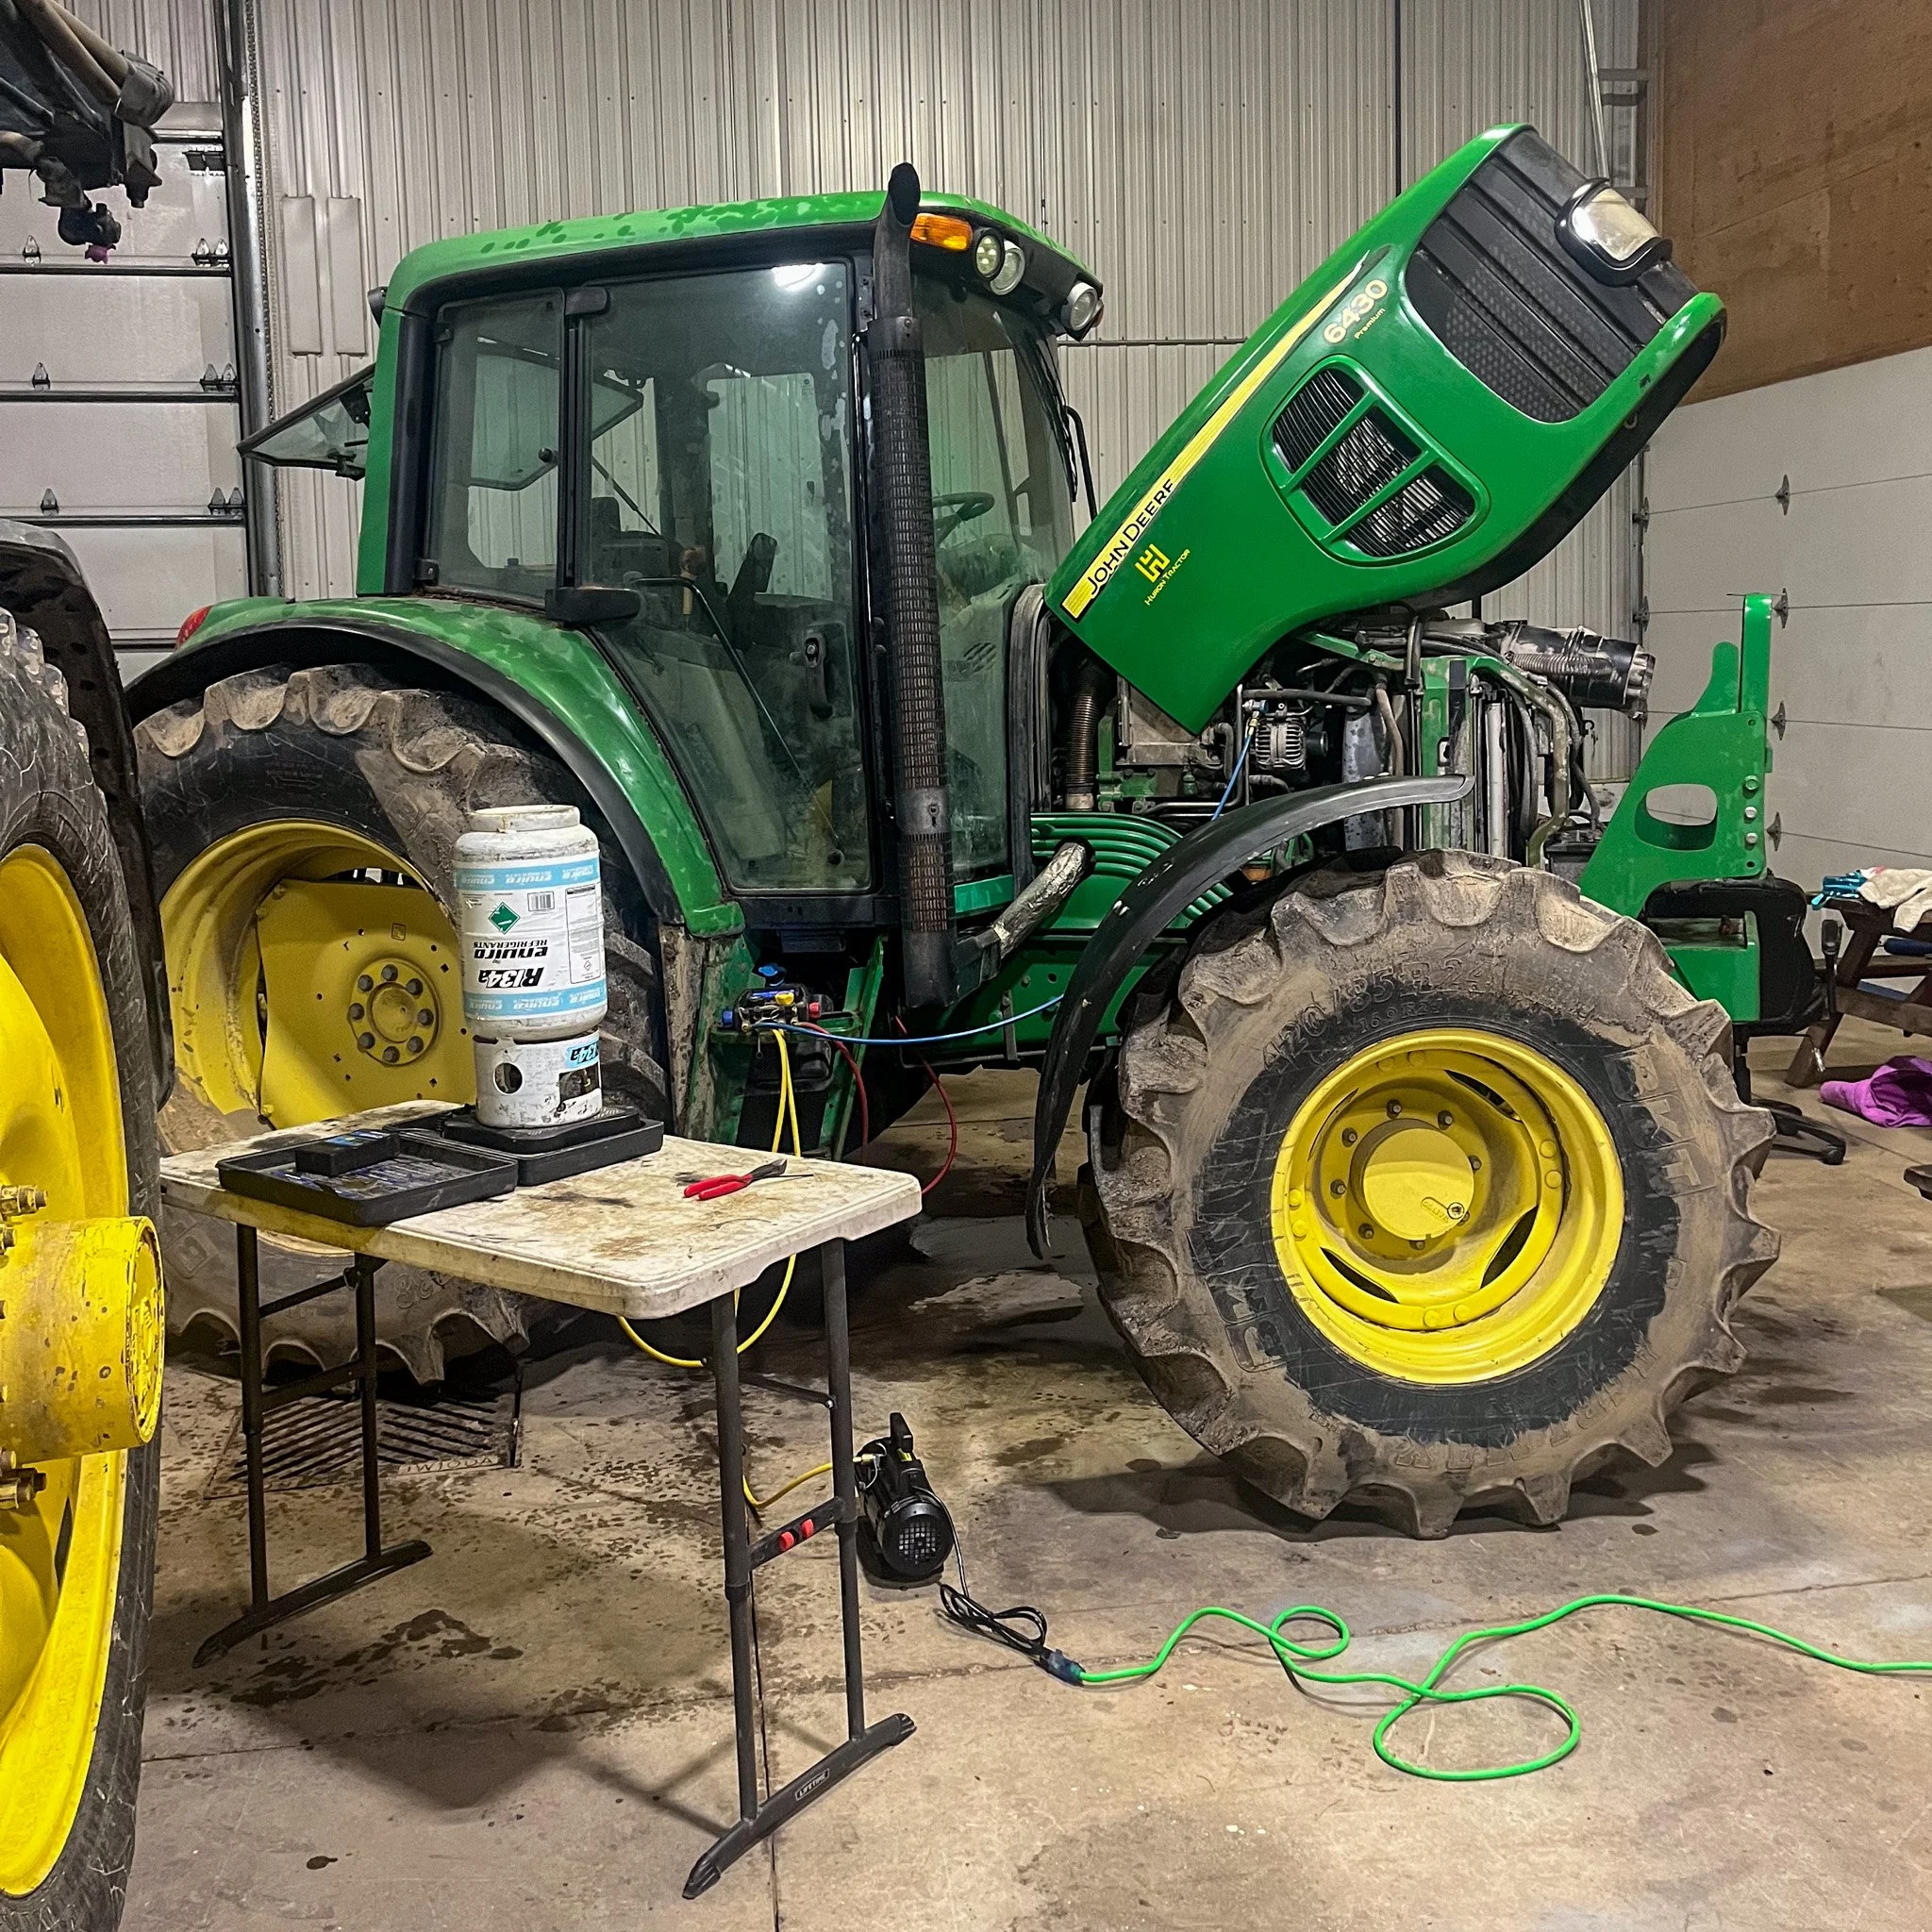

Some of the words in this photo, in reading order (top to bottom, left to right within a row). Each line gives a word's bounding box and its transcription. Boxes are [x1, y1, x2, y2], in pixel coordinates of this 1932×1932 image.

[1324, 278, 1389, 344] 6430
[1354, 308, 1387, 340] Premium
[1086, 539, 1130, 596] JOHN
[1162, 548, 1191, 581] TRACTOR
[473, 939, 548, 949] REFRIGERANTS
[473, 947, 548, 963] enviro
[477, 967, 544, 989] R134a
